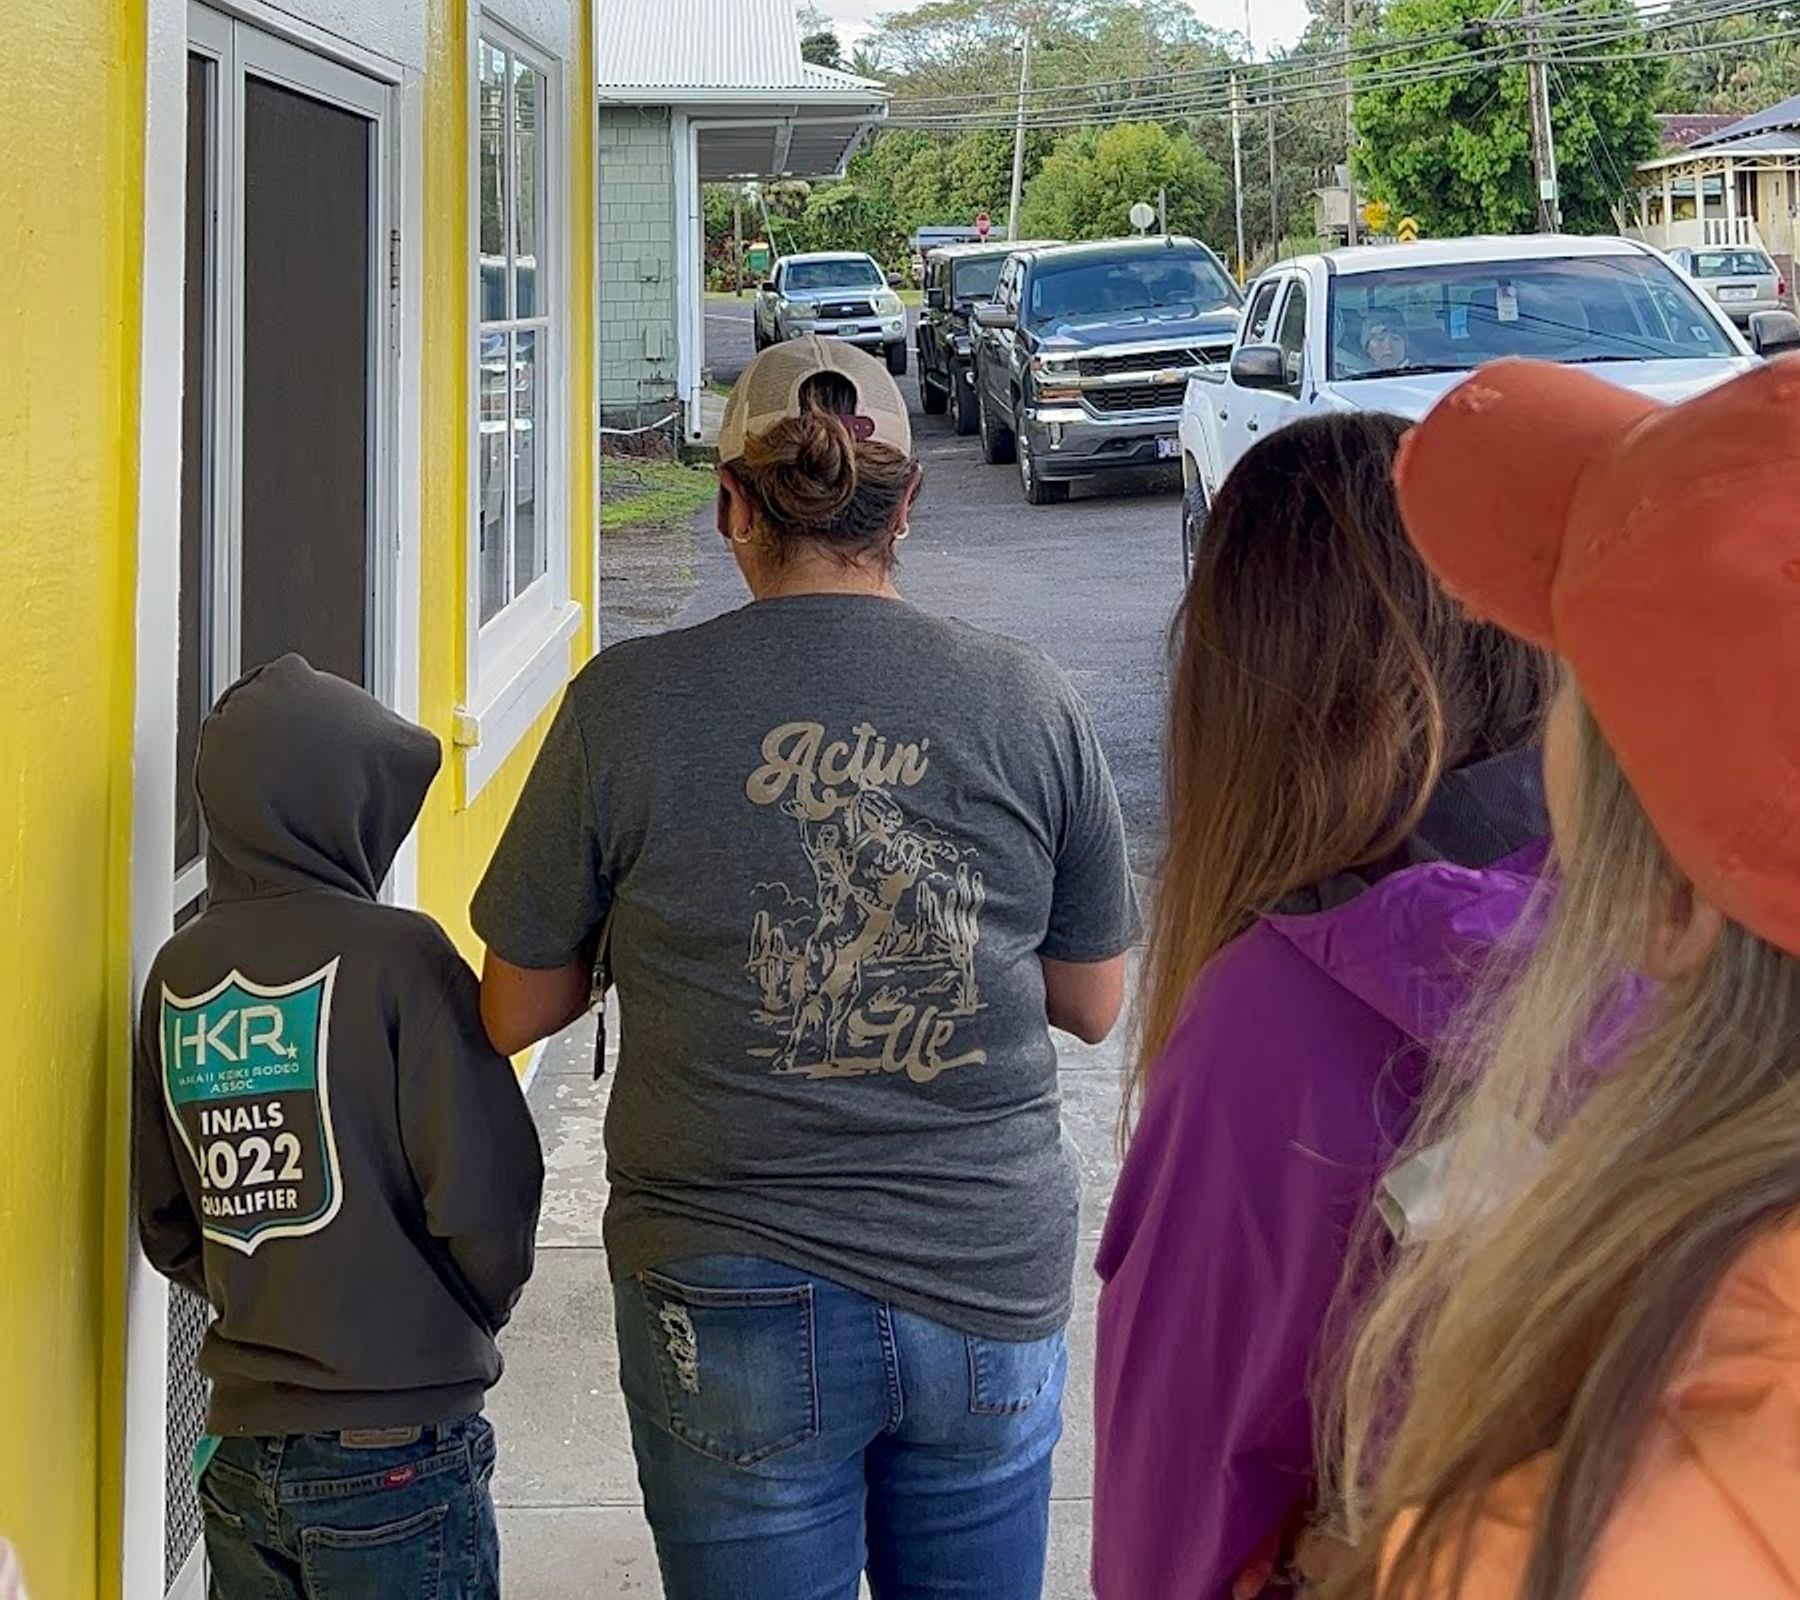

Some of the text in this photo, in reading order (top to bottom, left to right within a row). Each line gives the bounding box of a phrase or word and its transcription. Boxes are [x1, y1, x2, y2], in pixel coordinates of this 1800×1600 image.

[251, 1062, 300, 1077] RODEO
[202, 1102, 284, 1136] INALS
[202, 1188, 299, 1217] QUALIFIER
